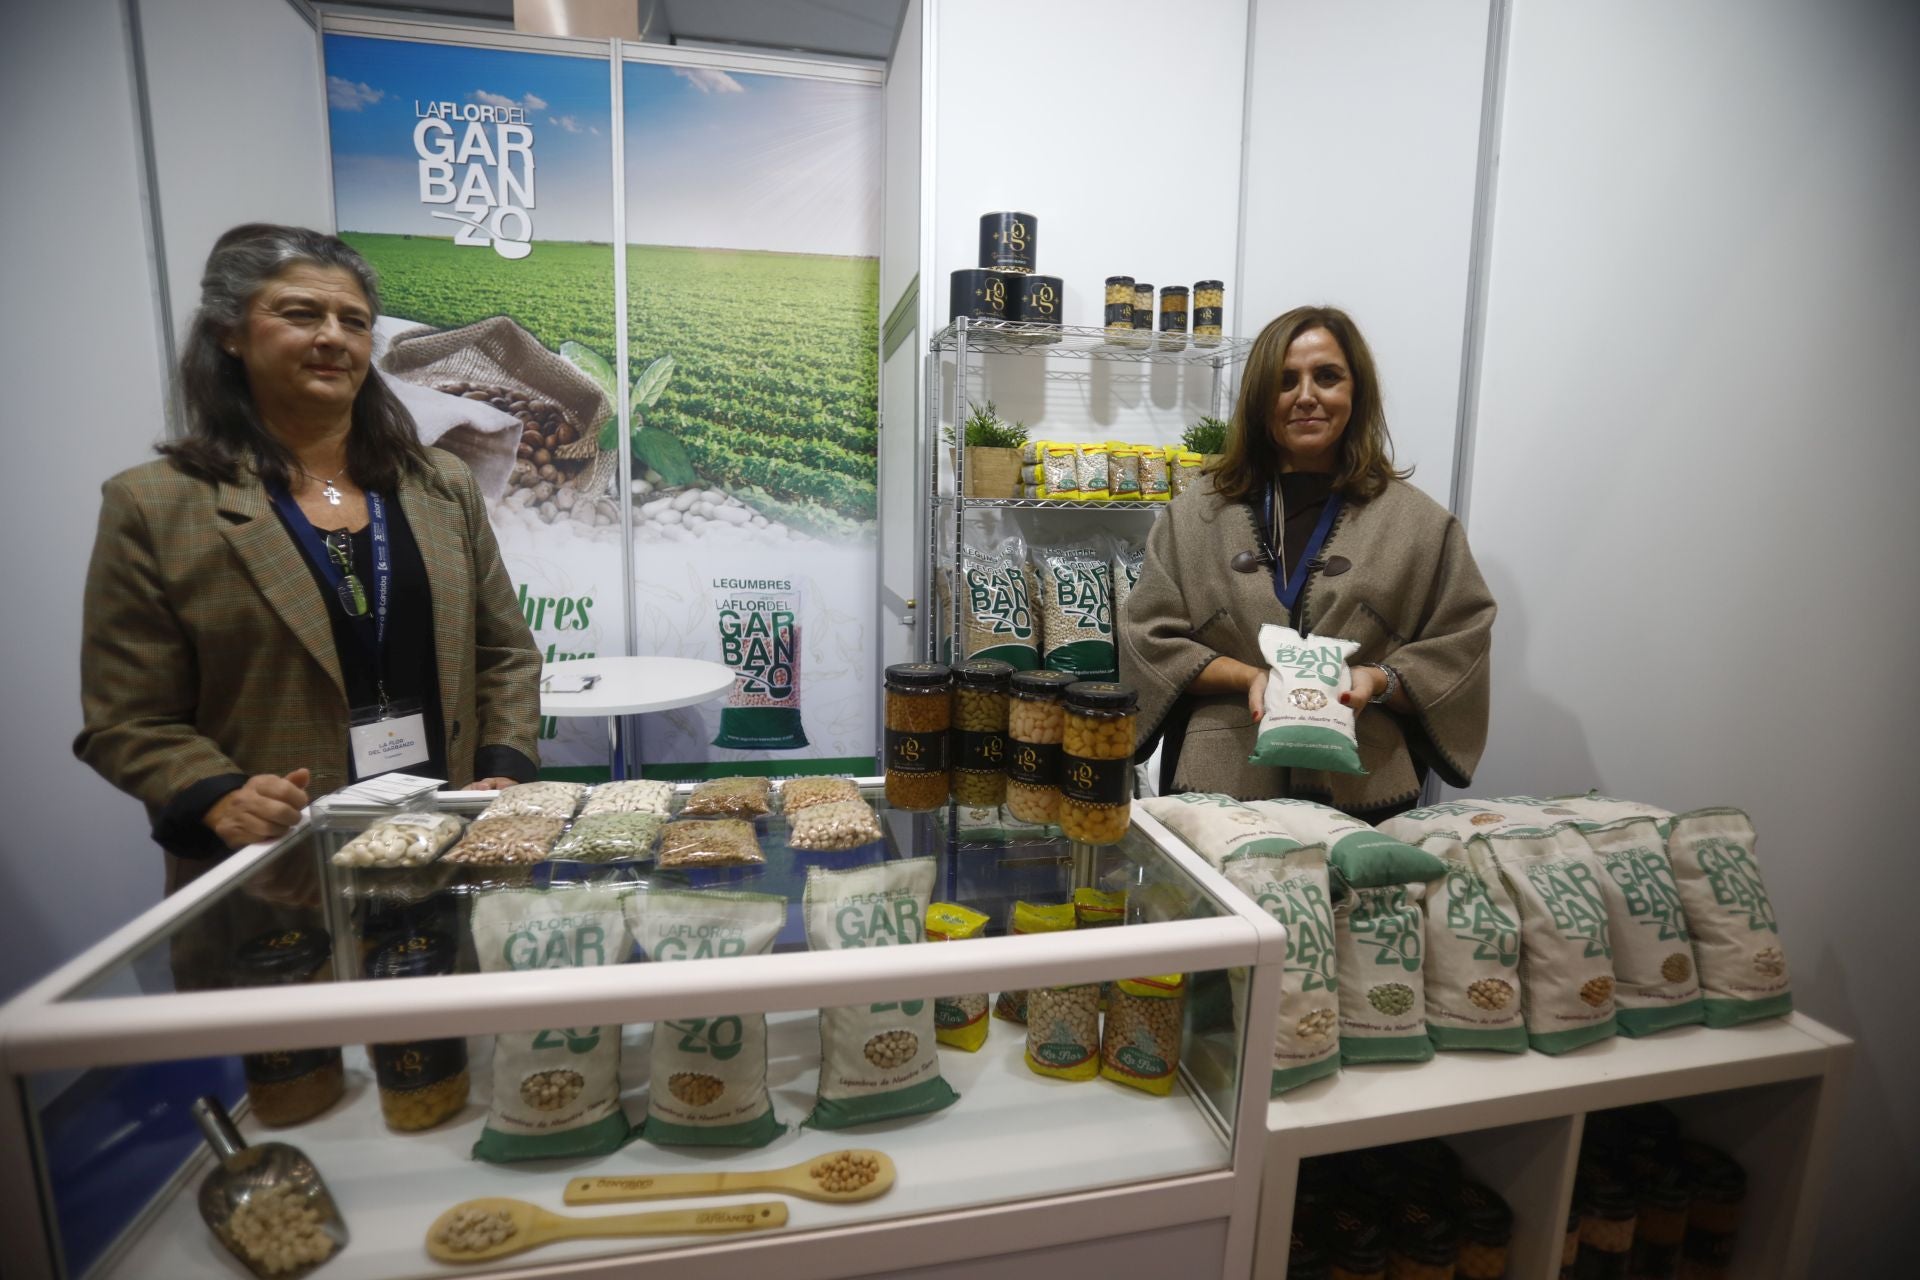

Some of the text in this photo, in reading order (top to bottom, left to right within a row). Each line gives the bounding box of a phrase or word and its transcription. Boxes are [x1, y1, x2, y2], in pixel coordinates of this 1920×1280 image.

[414, 117, 535, 168] GAR
[419, 160, 535, 209] BAN
[454, 203, 532, 259] ZO
[713, 578, 791, 590] LEGUMBRES
[971, 587, 1030, 612] BAN
[1058, 581, 1110, 605] BAN
[719, 610, 794, 638] GAR
[992, 608, 1031, 637] ZO
[1077, 604, 1111, 633] ZO
[722, 637, 794, 665] BAN
[1276, 646, 1343, 665] BAN
[742, 663, 793, 698] ZO
[1295, 661, 1340, 687] ZO
[1606, 854, 1675, 888] GAR
[836, 898, 921, 940] GAR
[503, 926, 605, 971] GAR
[1375, 931, 1421, 972] ZO
[1472, 926, 1518, 967] ZO
[678, 1015, 743, 1060] ZO
